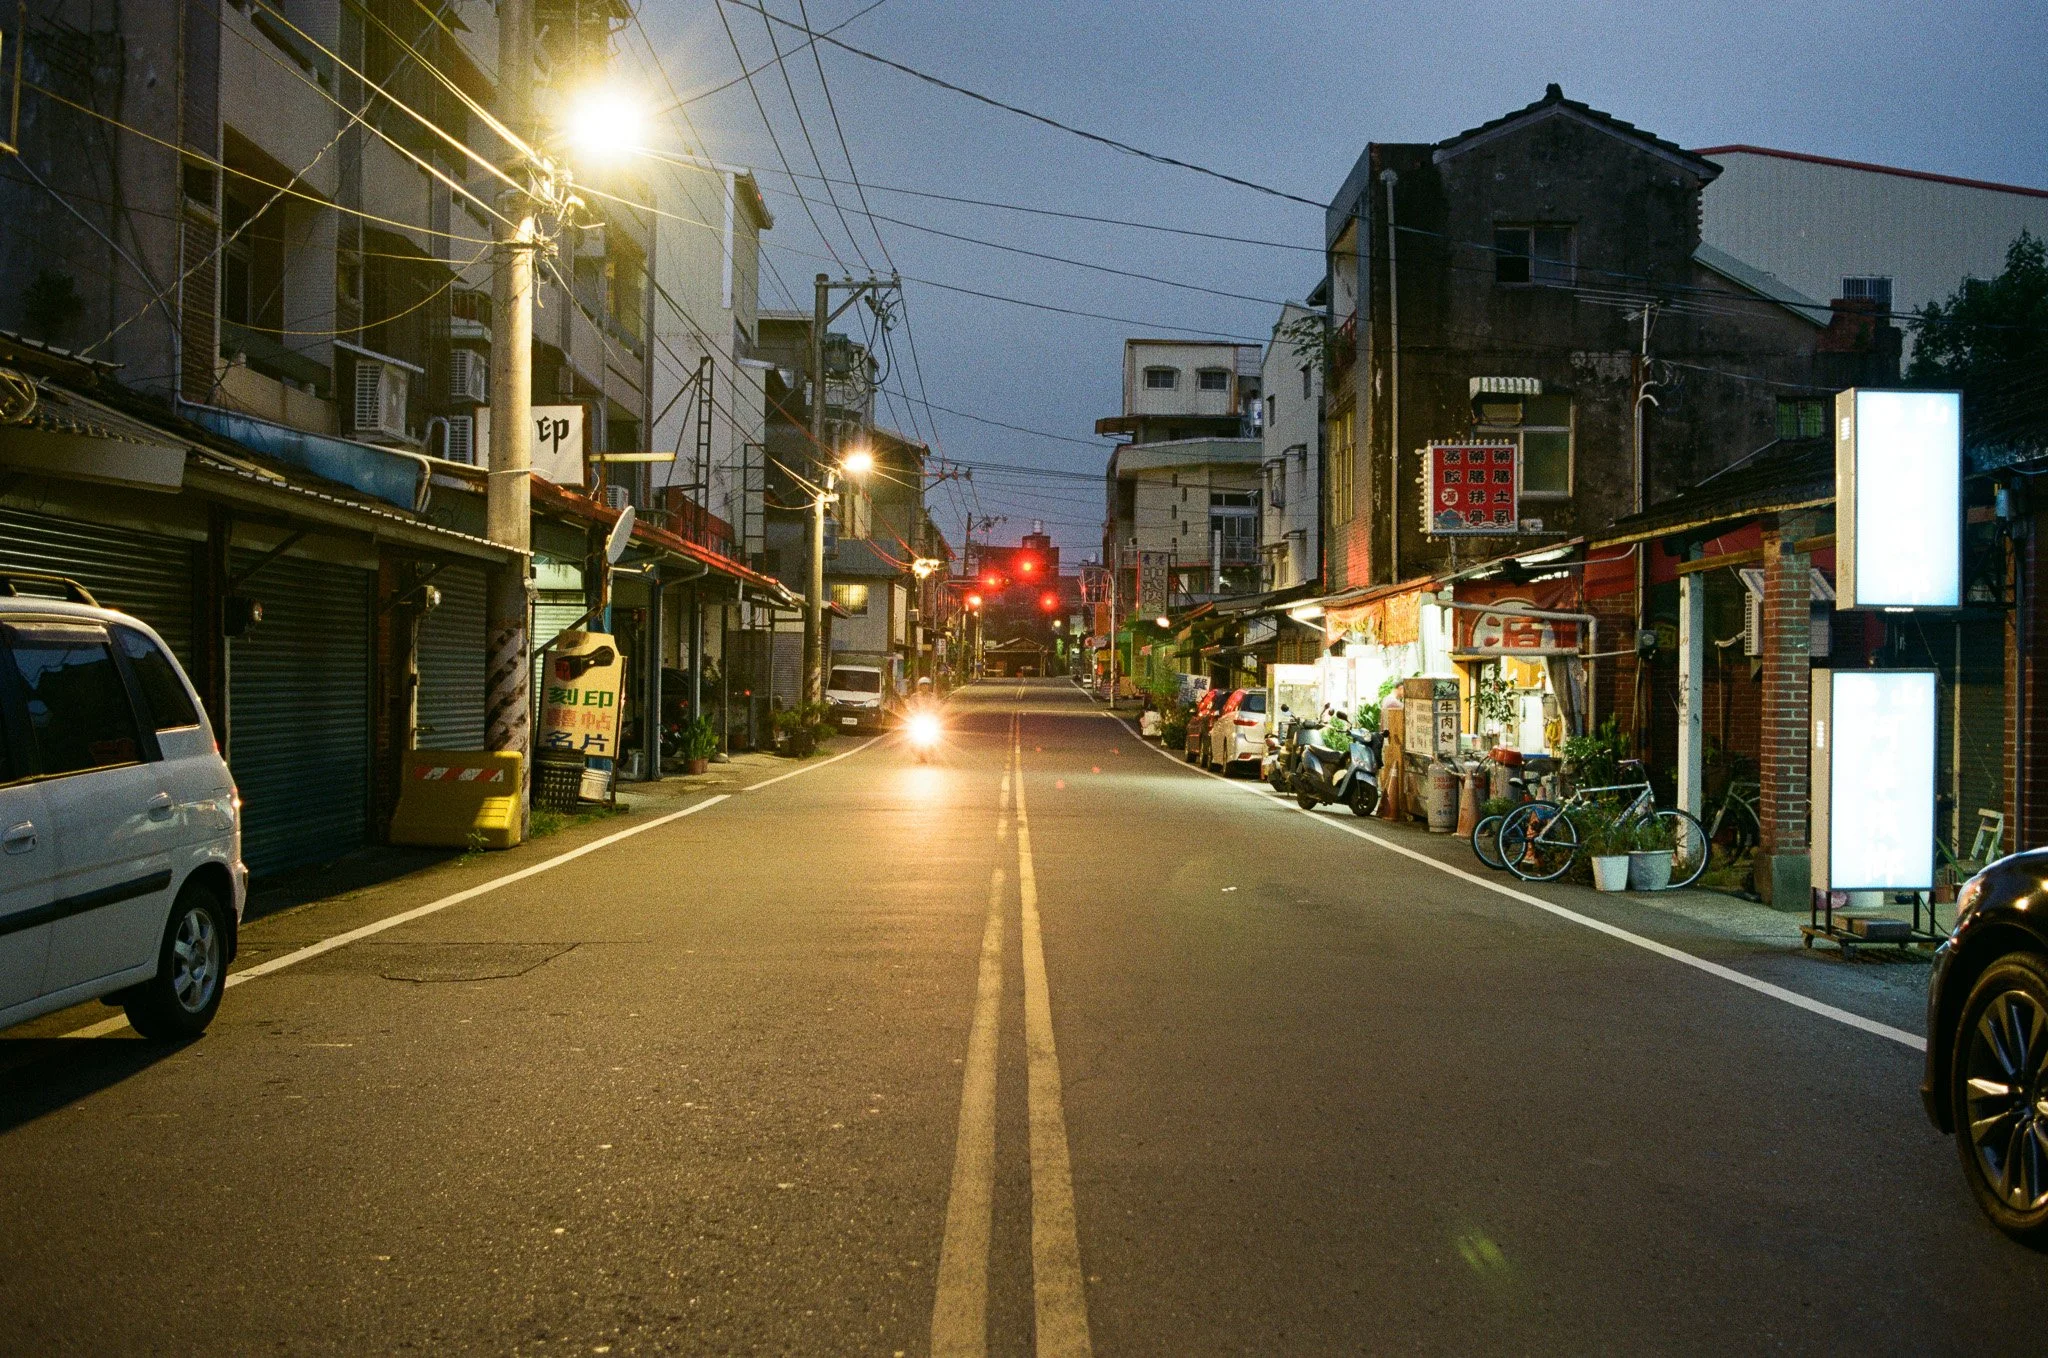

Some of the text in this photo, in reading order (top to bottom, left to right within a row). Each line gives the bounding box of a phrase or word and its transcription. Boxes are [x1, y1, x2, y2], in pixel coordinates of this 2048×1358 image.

[536, 415, 569, 455] 印
[1443, 448, 1462, 484] 蒸餃
[1467, 448, 1486, 524] 藥膳排骨
[1491, 448, 1511, 523] 藥膳土虱
[547, 686, 614, 708] 刻印
[544, 729, 610, 753] 名片
